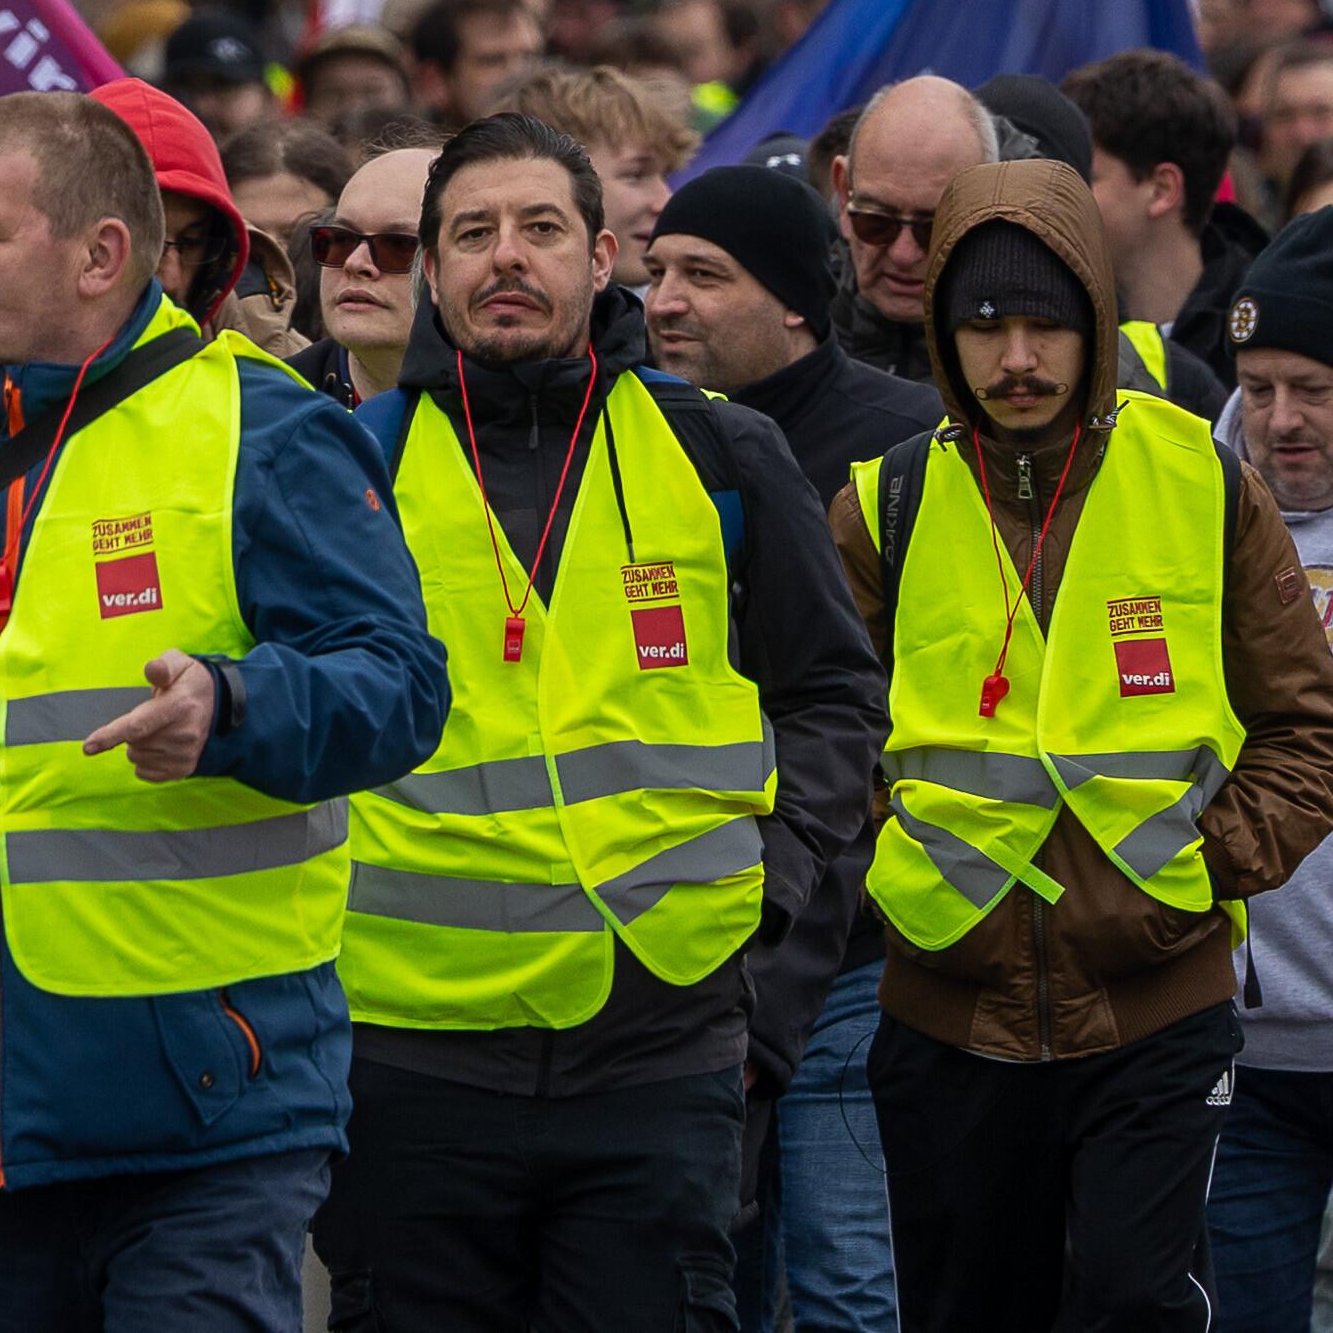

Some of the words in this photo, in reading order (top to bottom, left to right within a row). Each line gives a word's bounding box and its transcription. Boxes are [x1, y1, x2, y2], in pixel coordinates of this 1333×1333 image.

[93, 515, 152, 538] ZUSAMMEN
[93, 537, 121, 552] GEHT
[124, 529, 153, 546] MEHR
[622, 565, 676, 584] ZUSAMMEN
[102, 587, 158, 607] ver.di
[625, 584, 649, 598] GEHT
[651, 580, 679, 596] MEHR
[1108, 600, 1162, 618] ZUSAMMEN
[1109, 617, 1136, 632] GEHT
[1138, 614, 1164, 629] MEHR
[639, 642, 685, 659] ver.di
[1121, 672, 1170, 686] ver.di
